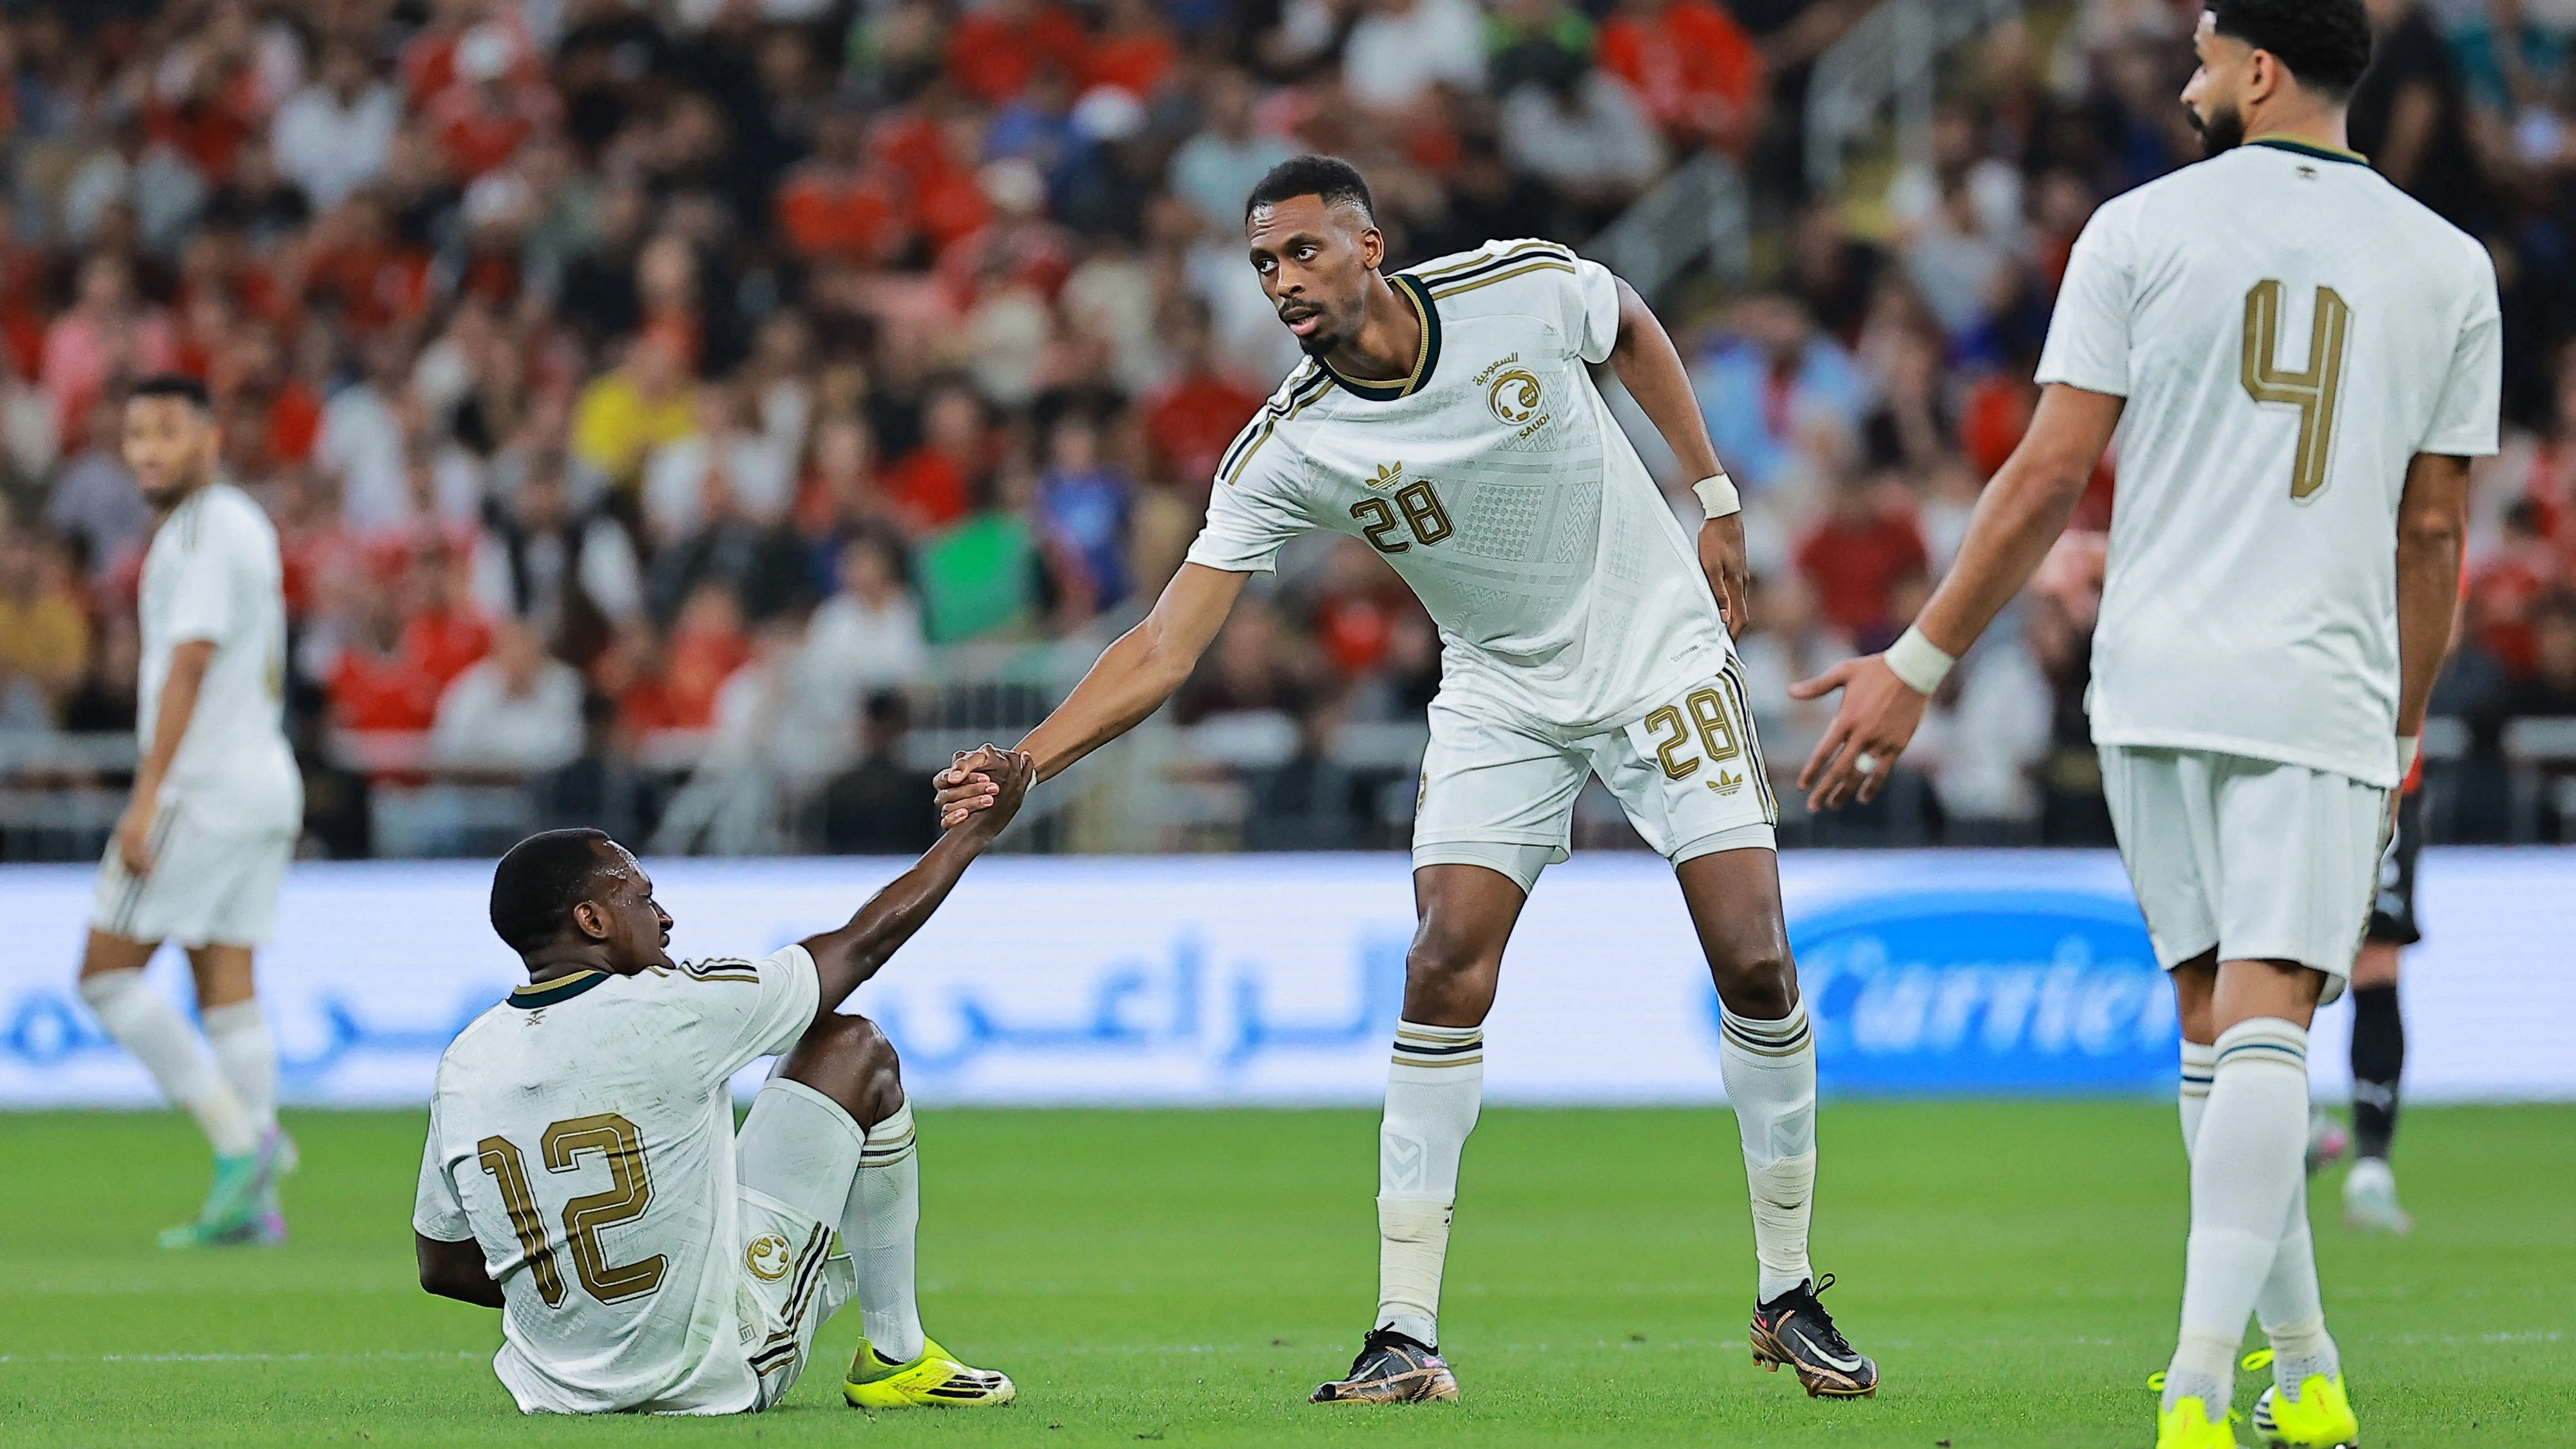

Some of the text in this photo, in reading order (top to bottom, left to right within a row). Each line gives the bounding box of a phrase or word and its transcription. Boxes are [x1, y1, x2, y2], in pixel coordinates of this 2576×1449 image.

[1472, 352, 1518, 386] السعودية
[2240, 278, 2354, 507] 4
[1519, 413, 1550, 439] SAUDI
[1350, 480, 1455, 554] 28
[1645, 688, 1741, 781] 28
[477, 1112, 668, 1309] 12
